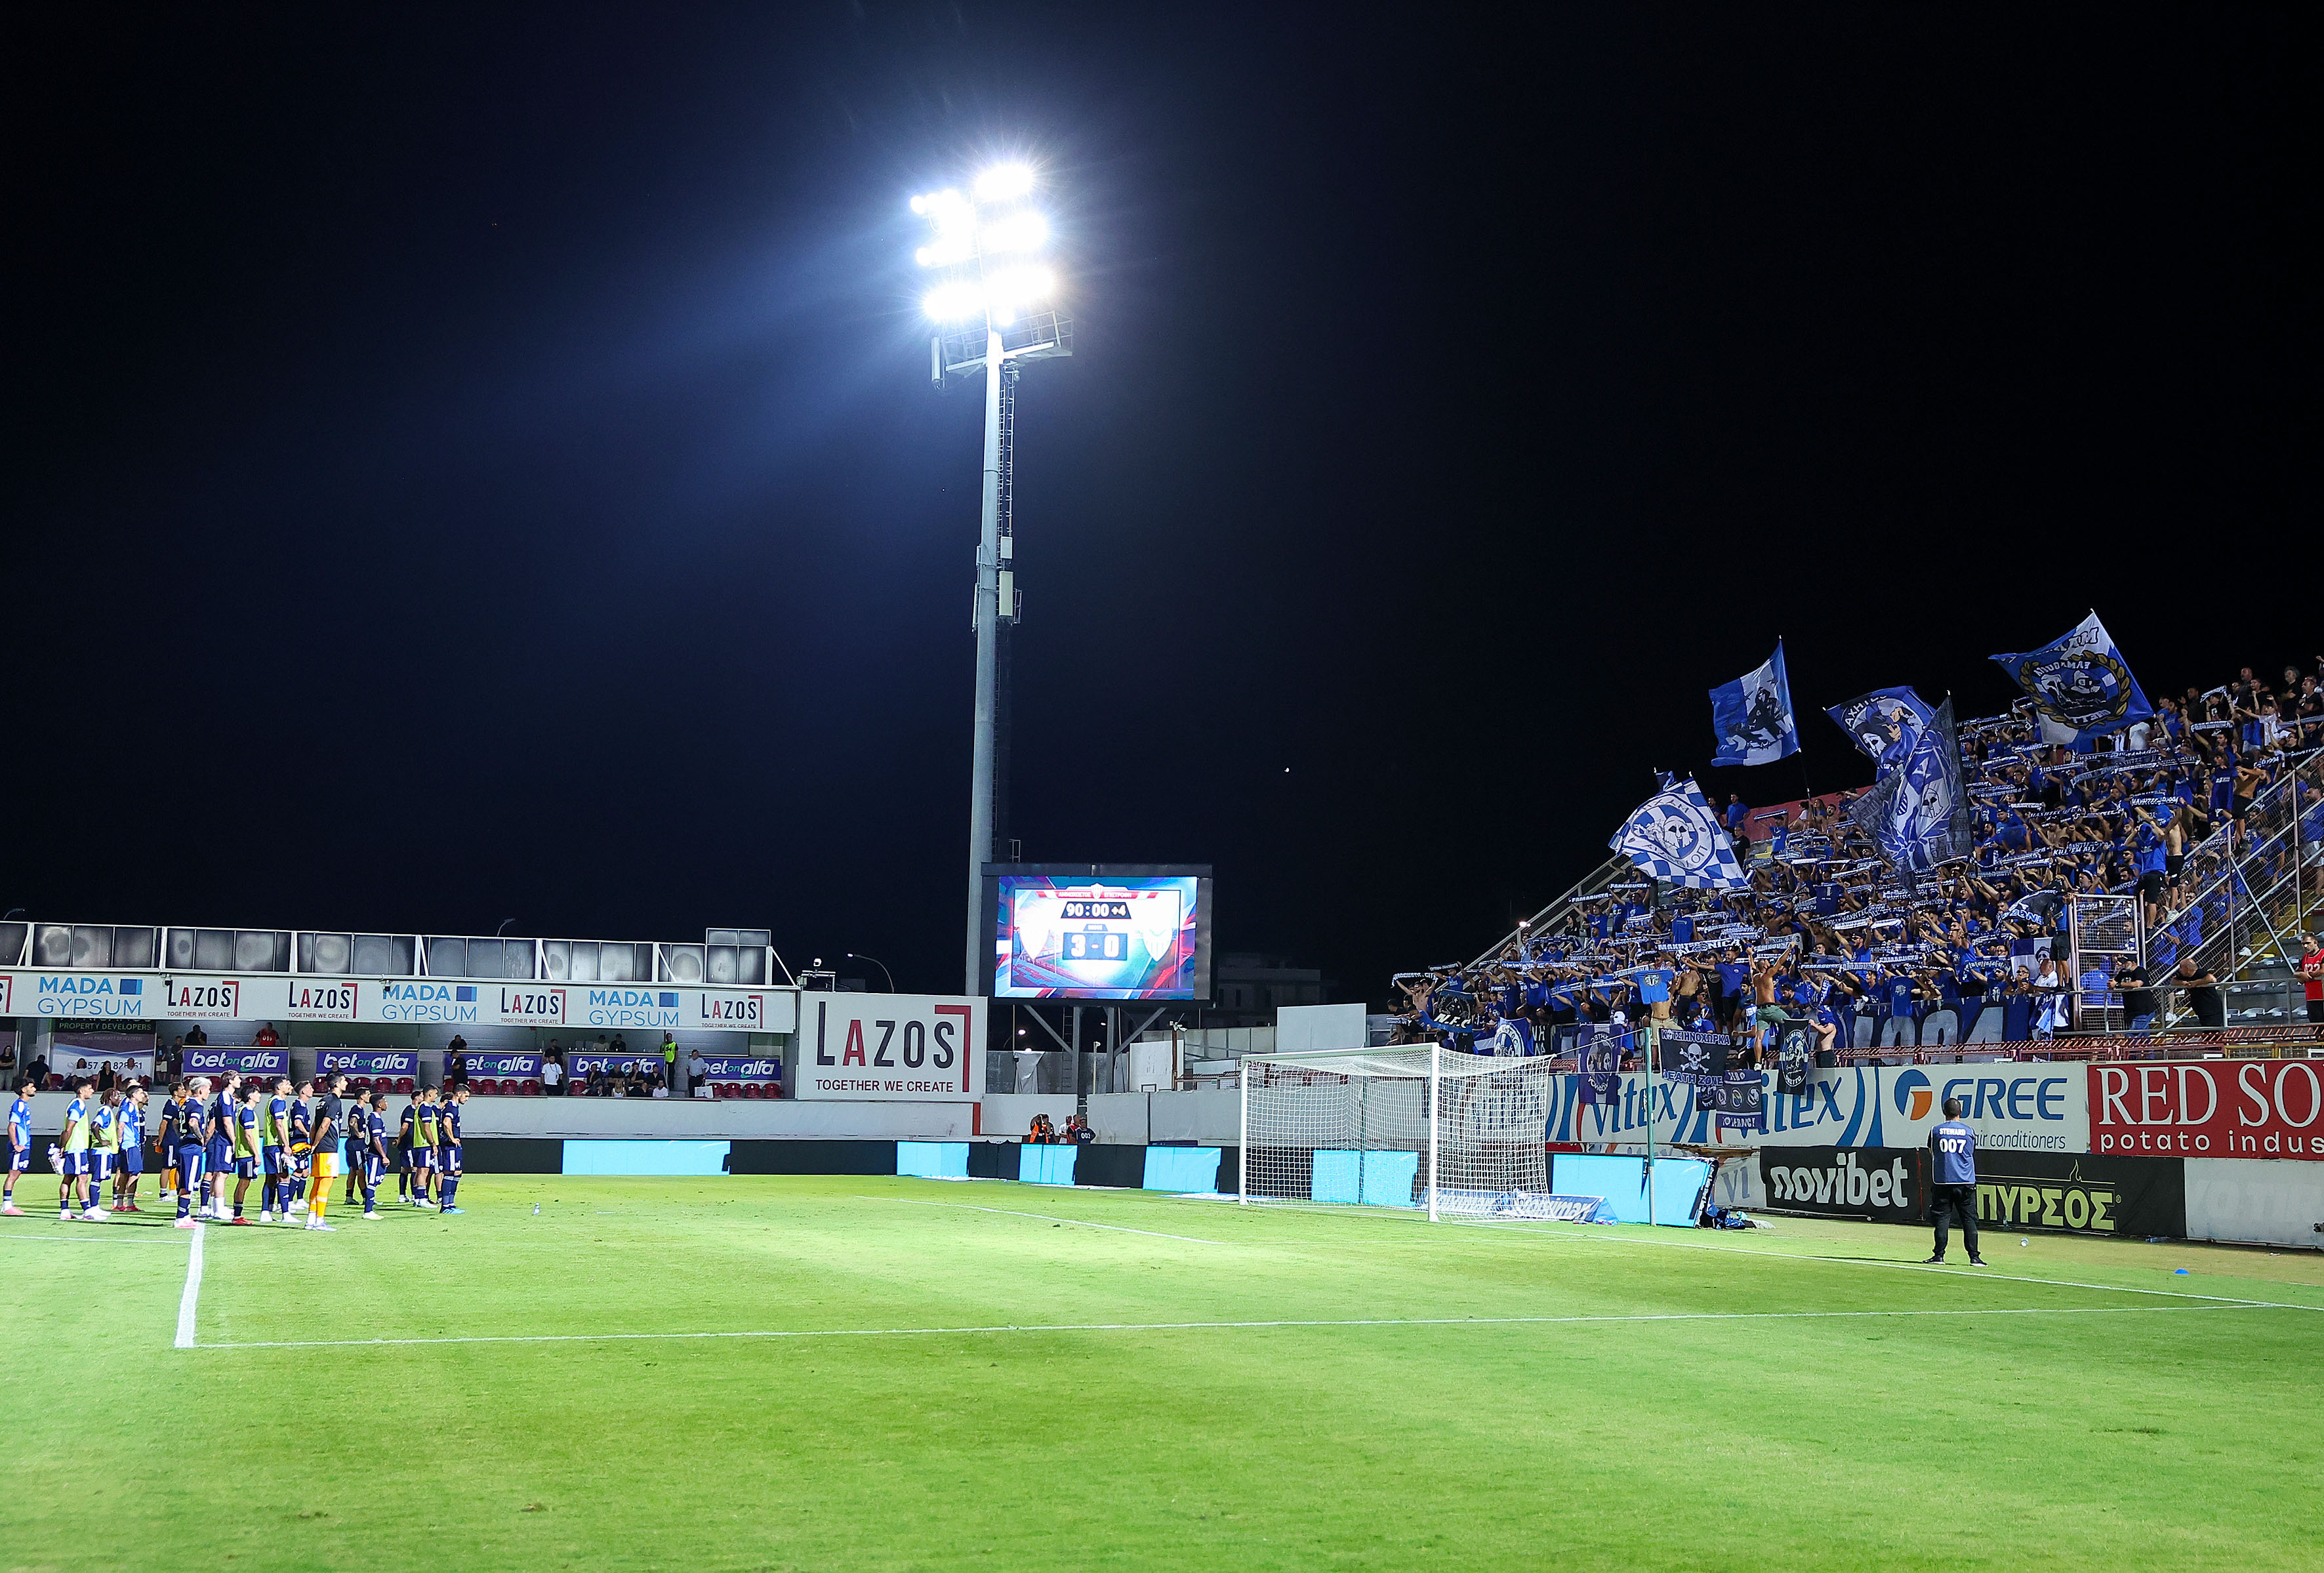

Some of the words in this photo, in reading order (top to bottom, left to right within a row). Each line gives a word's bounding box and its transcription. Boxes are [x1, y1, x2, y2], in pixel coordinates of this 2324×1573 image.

[1066, 903, 1110, 918] 90:00
[1111, 904, 1127, 917] +4
[1070, 934, 1086, 958] 3
[1104, 935, 1120, 958] 0
[39, 977, 113, 994] MADA
[168, 980, 232, 1008] LAZOS
[289, 981, 350, 1009] LAZOS
[382, 985, 451, 1001] MADA
[37, 998, 141, 1016] GYPSUM
[501, 987, 560, 1015] LAZOS
[590, 990, 654, 1007] MADA
[702, 993, 757, 1020] LAZOS
[382, 1004, 477, 1022] GYPSUM
[589, 1010, 679, 1027] GYPSUM
[817, 1001, 955, 1069] LAZOS
[815, 1079, 880, 1092] TOGETHER
[884, 1080, 903, 1092] WE
[907, 1081, 954, 1092] CREATE
[2096, 1065, 2218, 1126] RED
[2238, 1062, 2324, 1128] SO
[1941, 1078, 2068, 1120] GREE
[1939, 1128, 1967, 1137] STEWARD
[1989, 1130, 2066, 1149] conditioners
[2100, 1131, 2211, 1153] potato
[1939, 1137, 1967, 1154] 007
[1770, 1151, 1909, 1208] novibet
[1976, 1183, 2115, 1231] ΠΥΡΣΟΣ
